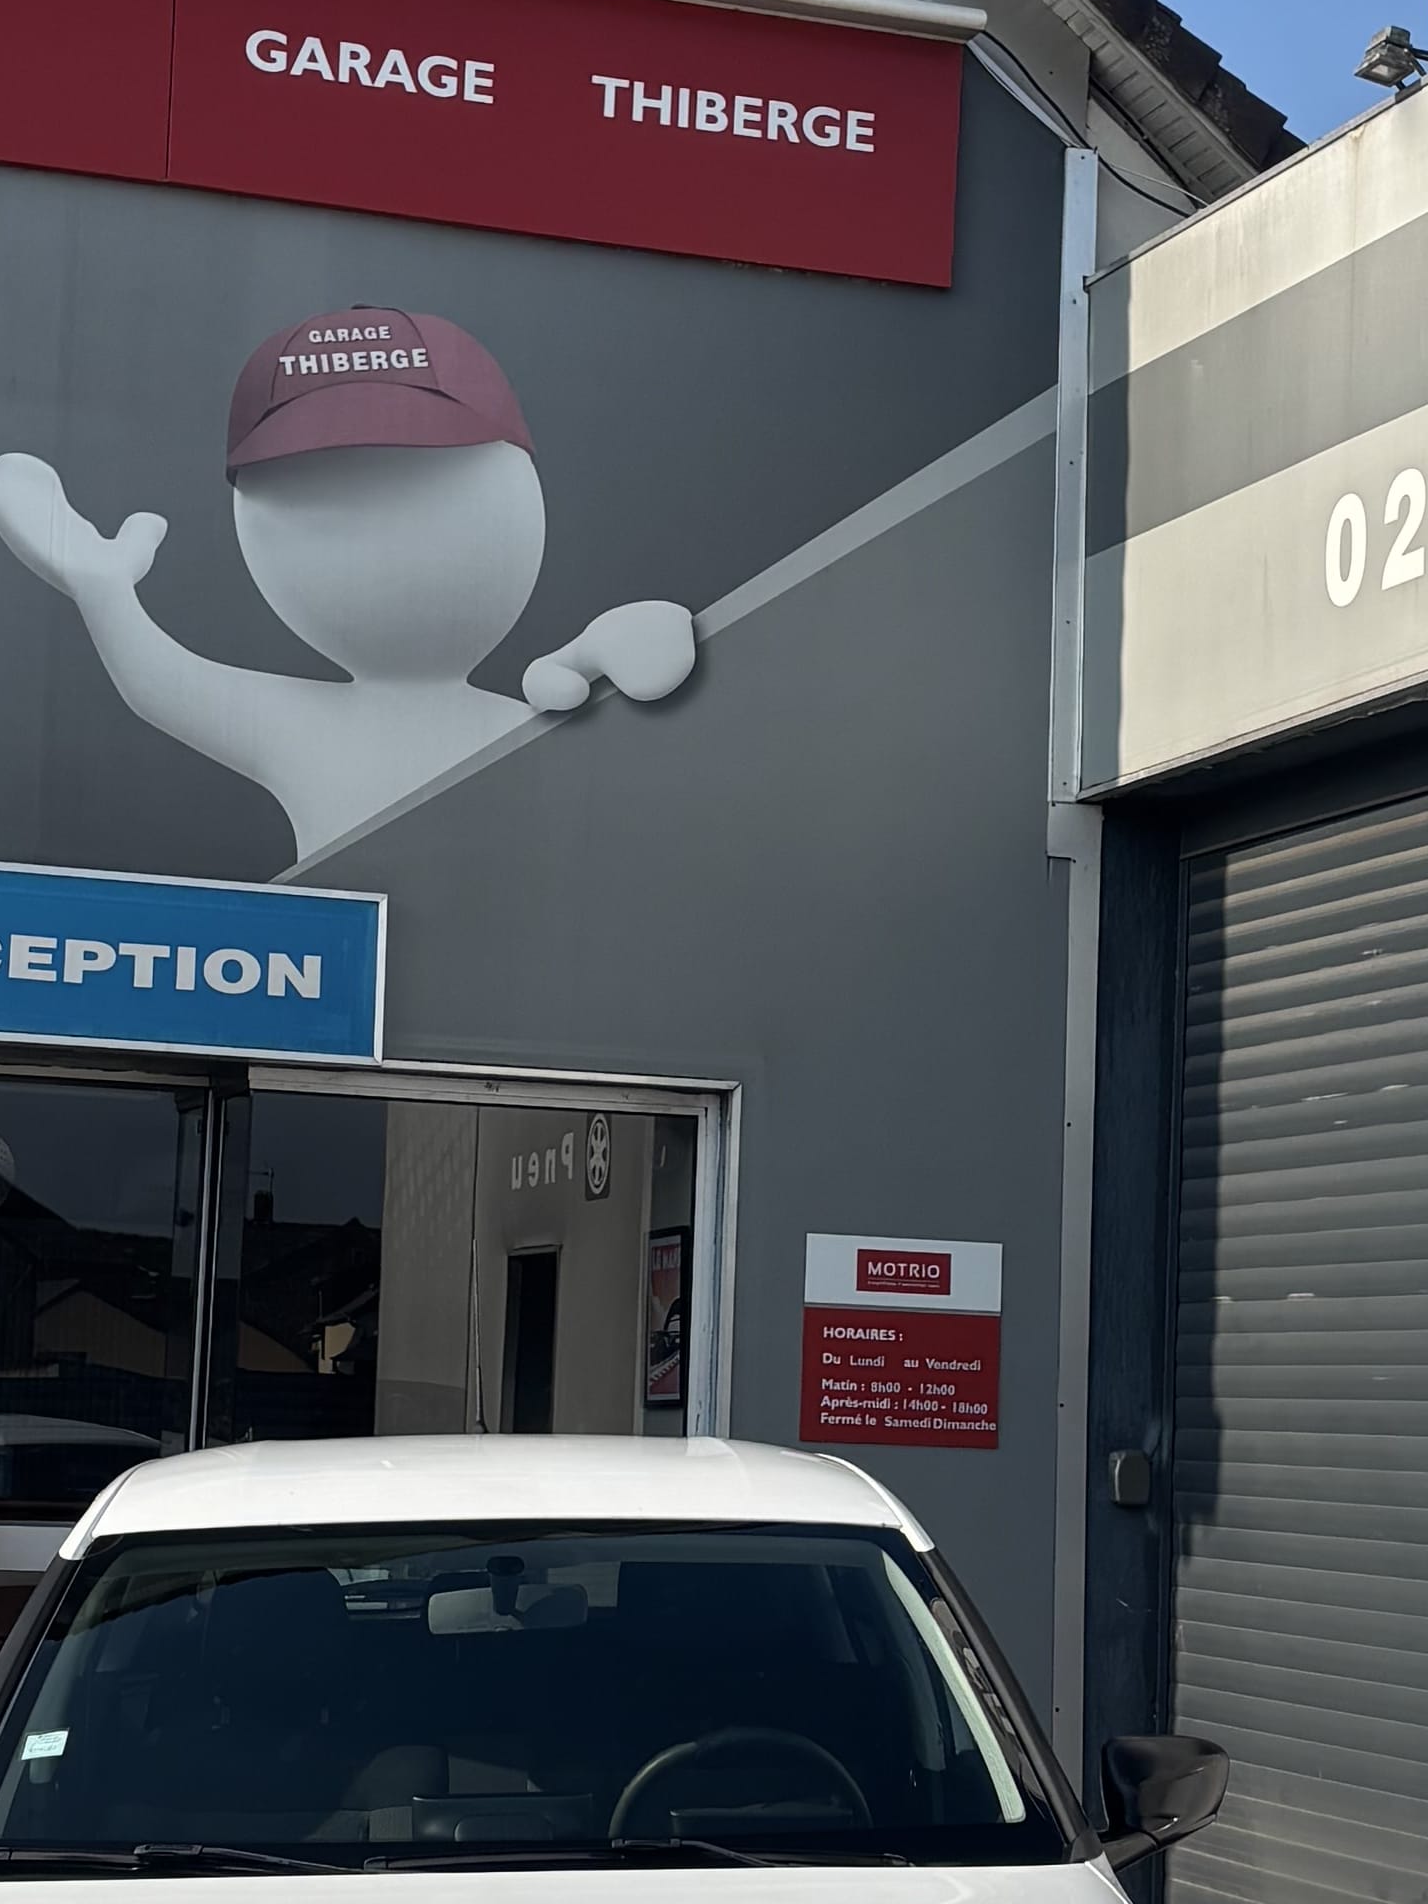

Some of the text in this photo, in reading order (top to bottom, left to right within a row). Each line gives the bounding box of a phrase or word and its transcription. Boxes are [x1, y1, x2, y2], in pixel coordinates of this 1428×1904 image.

[244, 28, 876, 154] GARAGE THIBERGE
[308, 325, 391, 345] GARAGE
[278, 347, 430, 377] THIBERGE
[823, 1326, 896, 1341] HORAIRES
[822, 1352, 982, 1371] Du Lundi au Vendredi
[821, 1378, 858, 1392] Matin
[870, 1382, 901, 1394] 8h00
[919, 1383, 956, 1396] 12h00
[820, 1395, 891, 1411] Après-midi
[902, 1400, 939, 1412] 14h00
[952, 1401, 988, 1415] 18h00
[820, 1412, 862, 1426] Fermé
[865, 1413, 877, 1426] le
